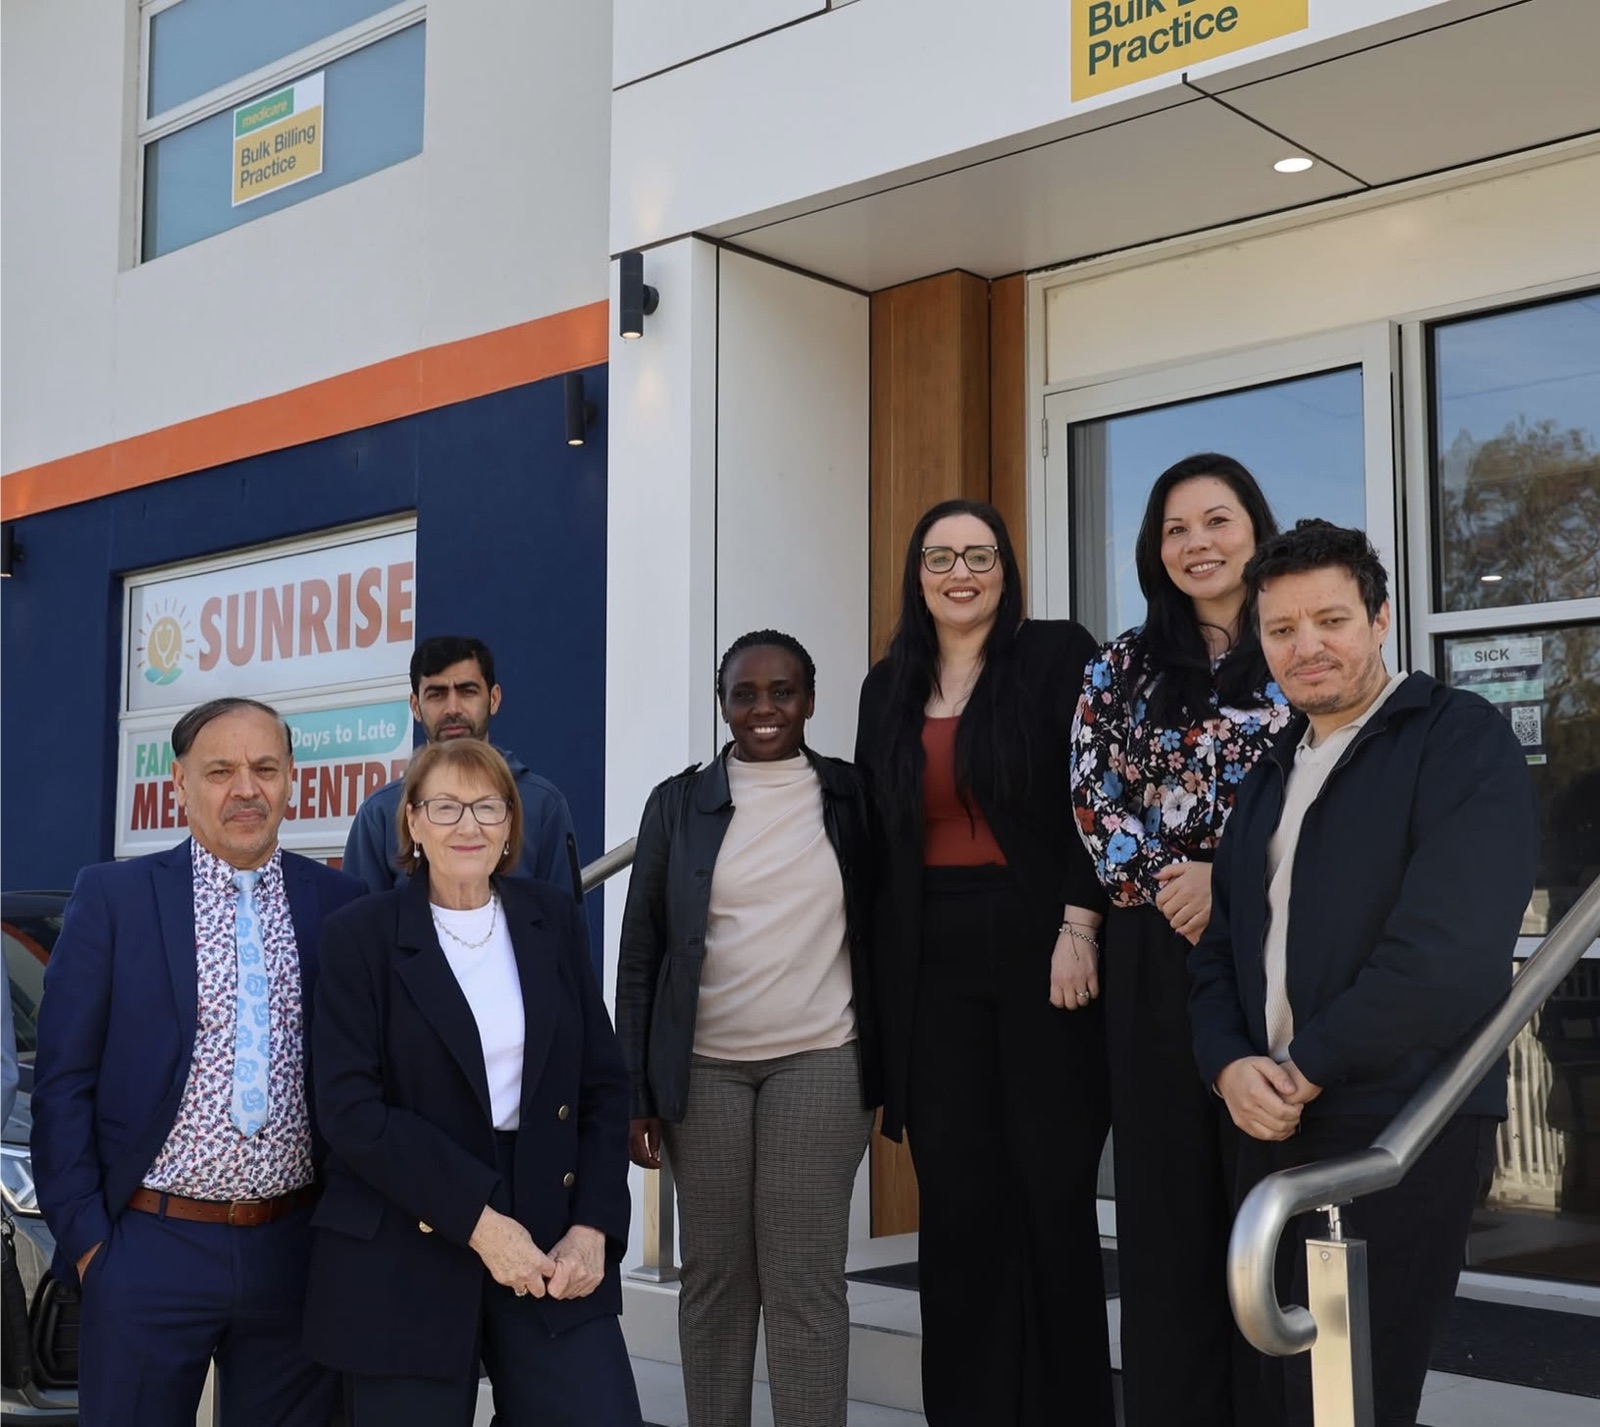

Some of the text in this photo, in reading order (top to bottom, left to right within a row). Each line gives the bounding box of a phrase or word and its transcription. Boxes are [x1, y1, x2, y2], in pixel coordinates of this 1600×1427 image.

[1089, 0, 1167, 37] Bulk
[1089, 5, 1238, 76] Practice
[242, 99, 288, 128] medicare
[241, 124, 316, 167] Bulk Billing
[240, 155, 296, 188] Practice
[198, 561, 414, 672] SUNRISE
[291, 718, 396, 753] Days to Late
[136, 741, 174, 777] FAM
